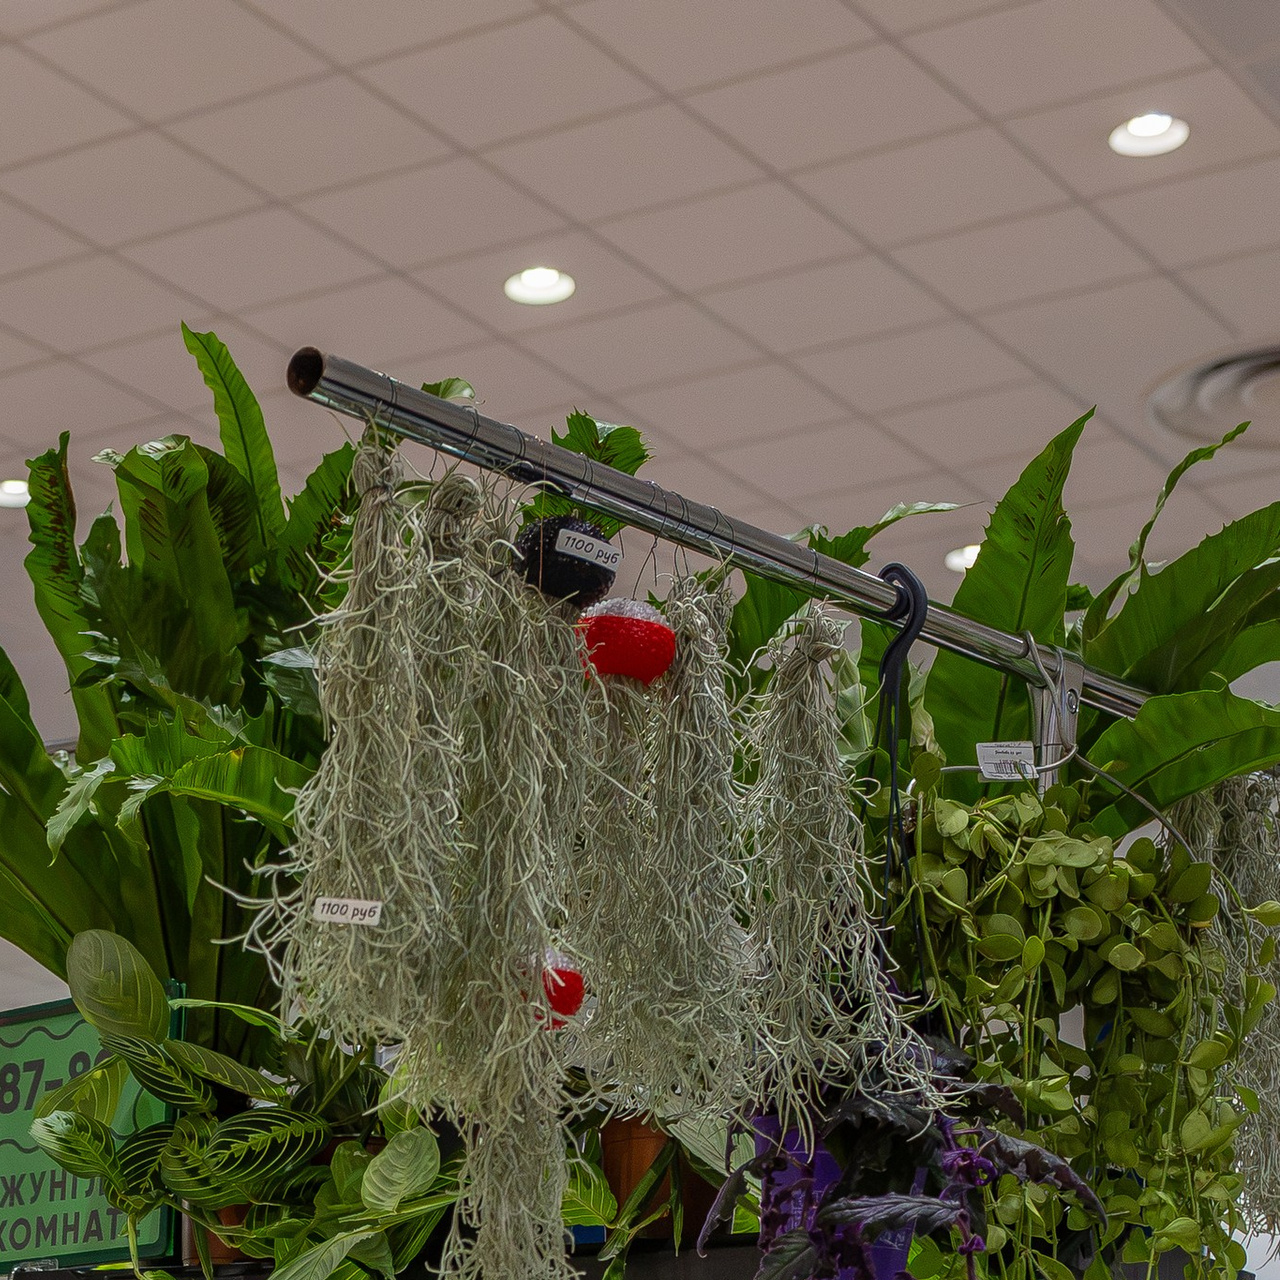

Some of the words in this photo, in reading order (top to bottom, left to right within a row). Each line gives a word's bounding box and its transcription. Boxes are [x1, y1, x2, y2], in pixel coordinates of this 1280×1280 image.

[564, 535, 595, 554] 1100
[594, 548, 620, 564] руб
[320, 902, 348, 916] 1100
[351, 905, 379, 921] руб
